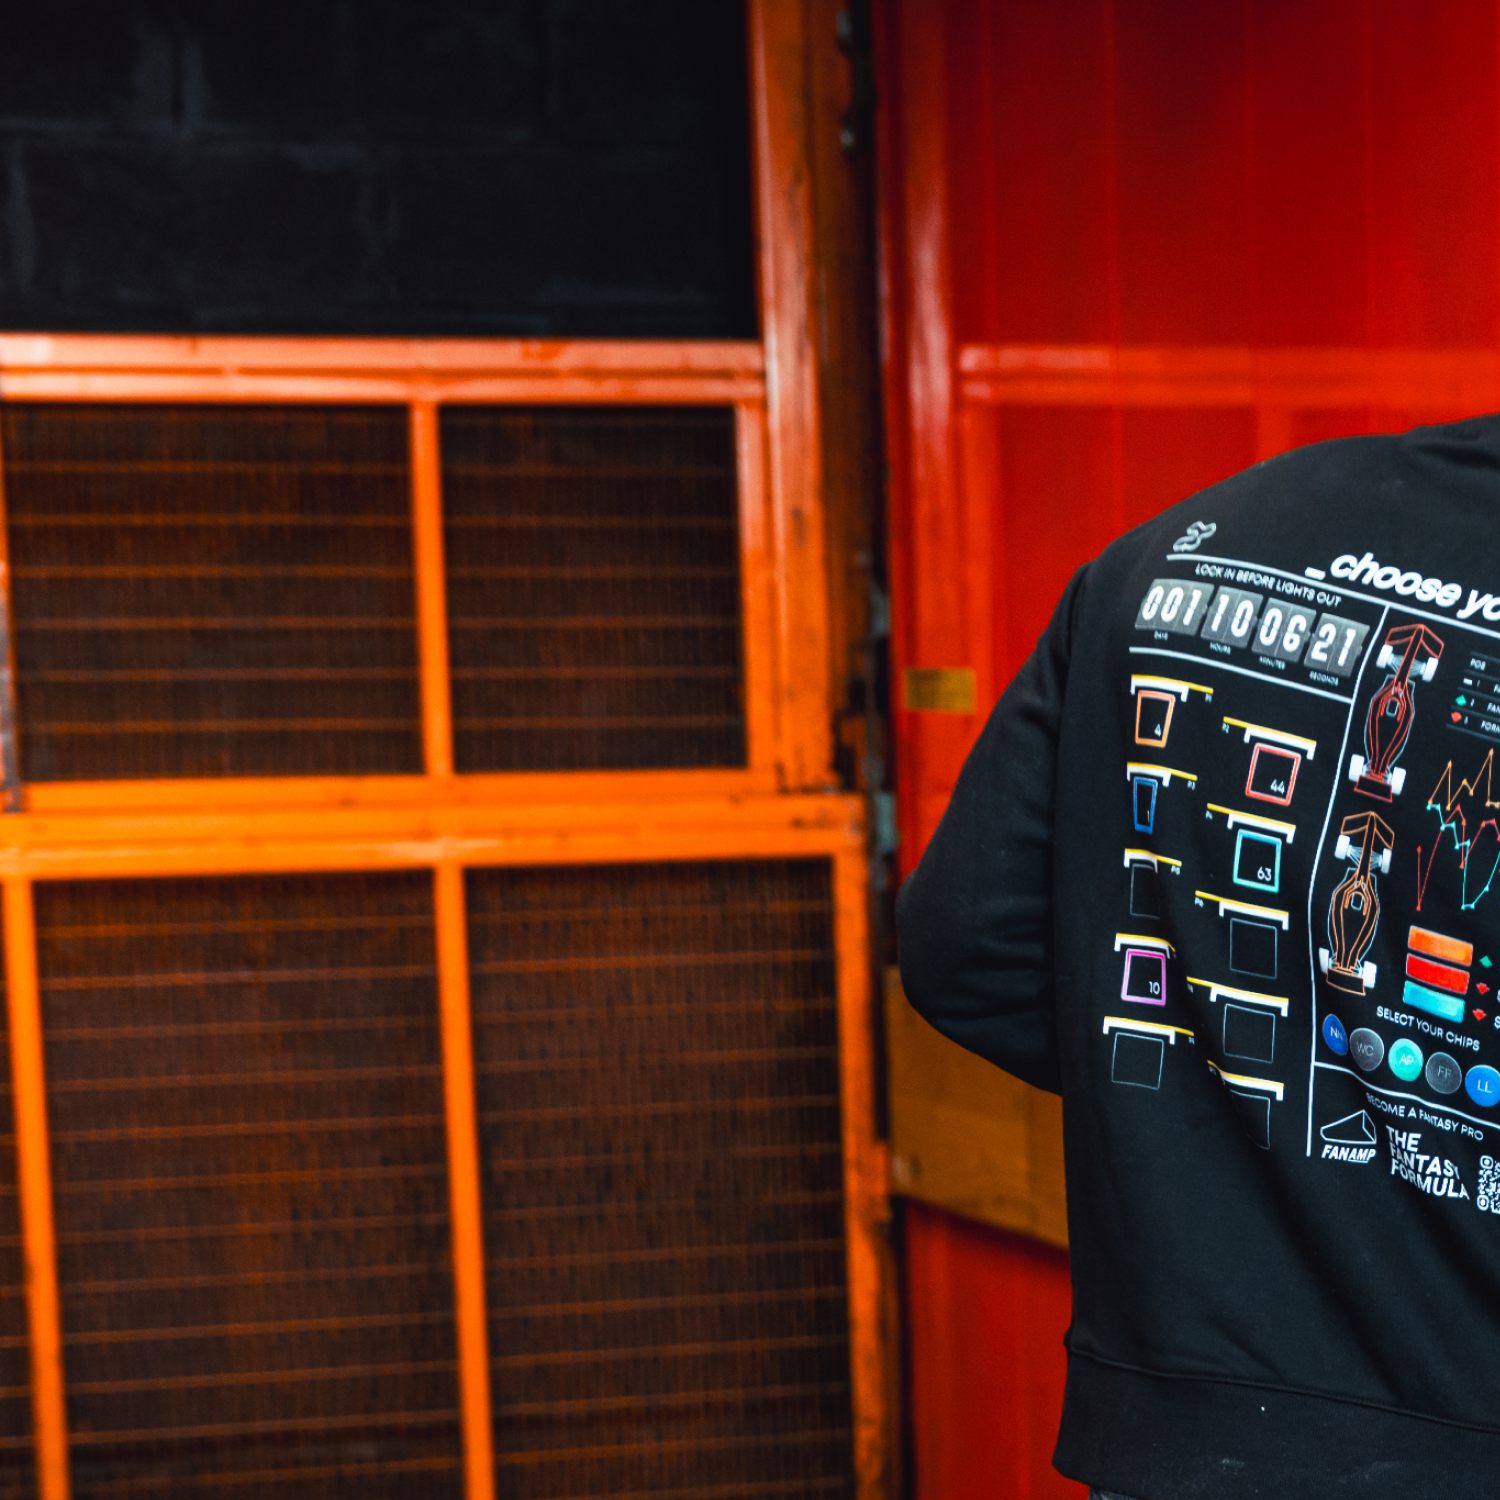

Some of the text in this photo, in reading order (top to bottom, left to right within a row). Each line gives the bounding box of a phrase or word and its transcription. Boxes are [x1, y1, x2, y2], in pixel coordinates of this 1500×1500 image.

[1195, 562, 1341, 607] LOCK IN BEFORE LIGHTS OUT
[1141, 586, 1356, 667] 001 10 06 21
[1154, 723, 1162, 737] 4
[1270, 779, 1285, 795] 44
[1257, 867, 1272, 882] 63
[1149, 980, 1160, 995] 10
[1376, 1006, 1480, 1051] SELECT YOUR CHIPS
[1356, 1041, 1374, 1057] WC
[1399, 1053, 1414, 1067] AP
[1437, 1066, 1452, 1079] FF
[1477, 1079, 1493, 1093] LL
[1386, 1125, 1422, 1153] THE
[1408, 1107, 1417, 1119] A
[1419, 1109, 1459, 1132] FANTASY
[1460, 1124, 1484, 1141] PRO
[1321, 1144, 1376, 1162] FANAMP
[1391, 1158, 1470, 1200] FORMULA
